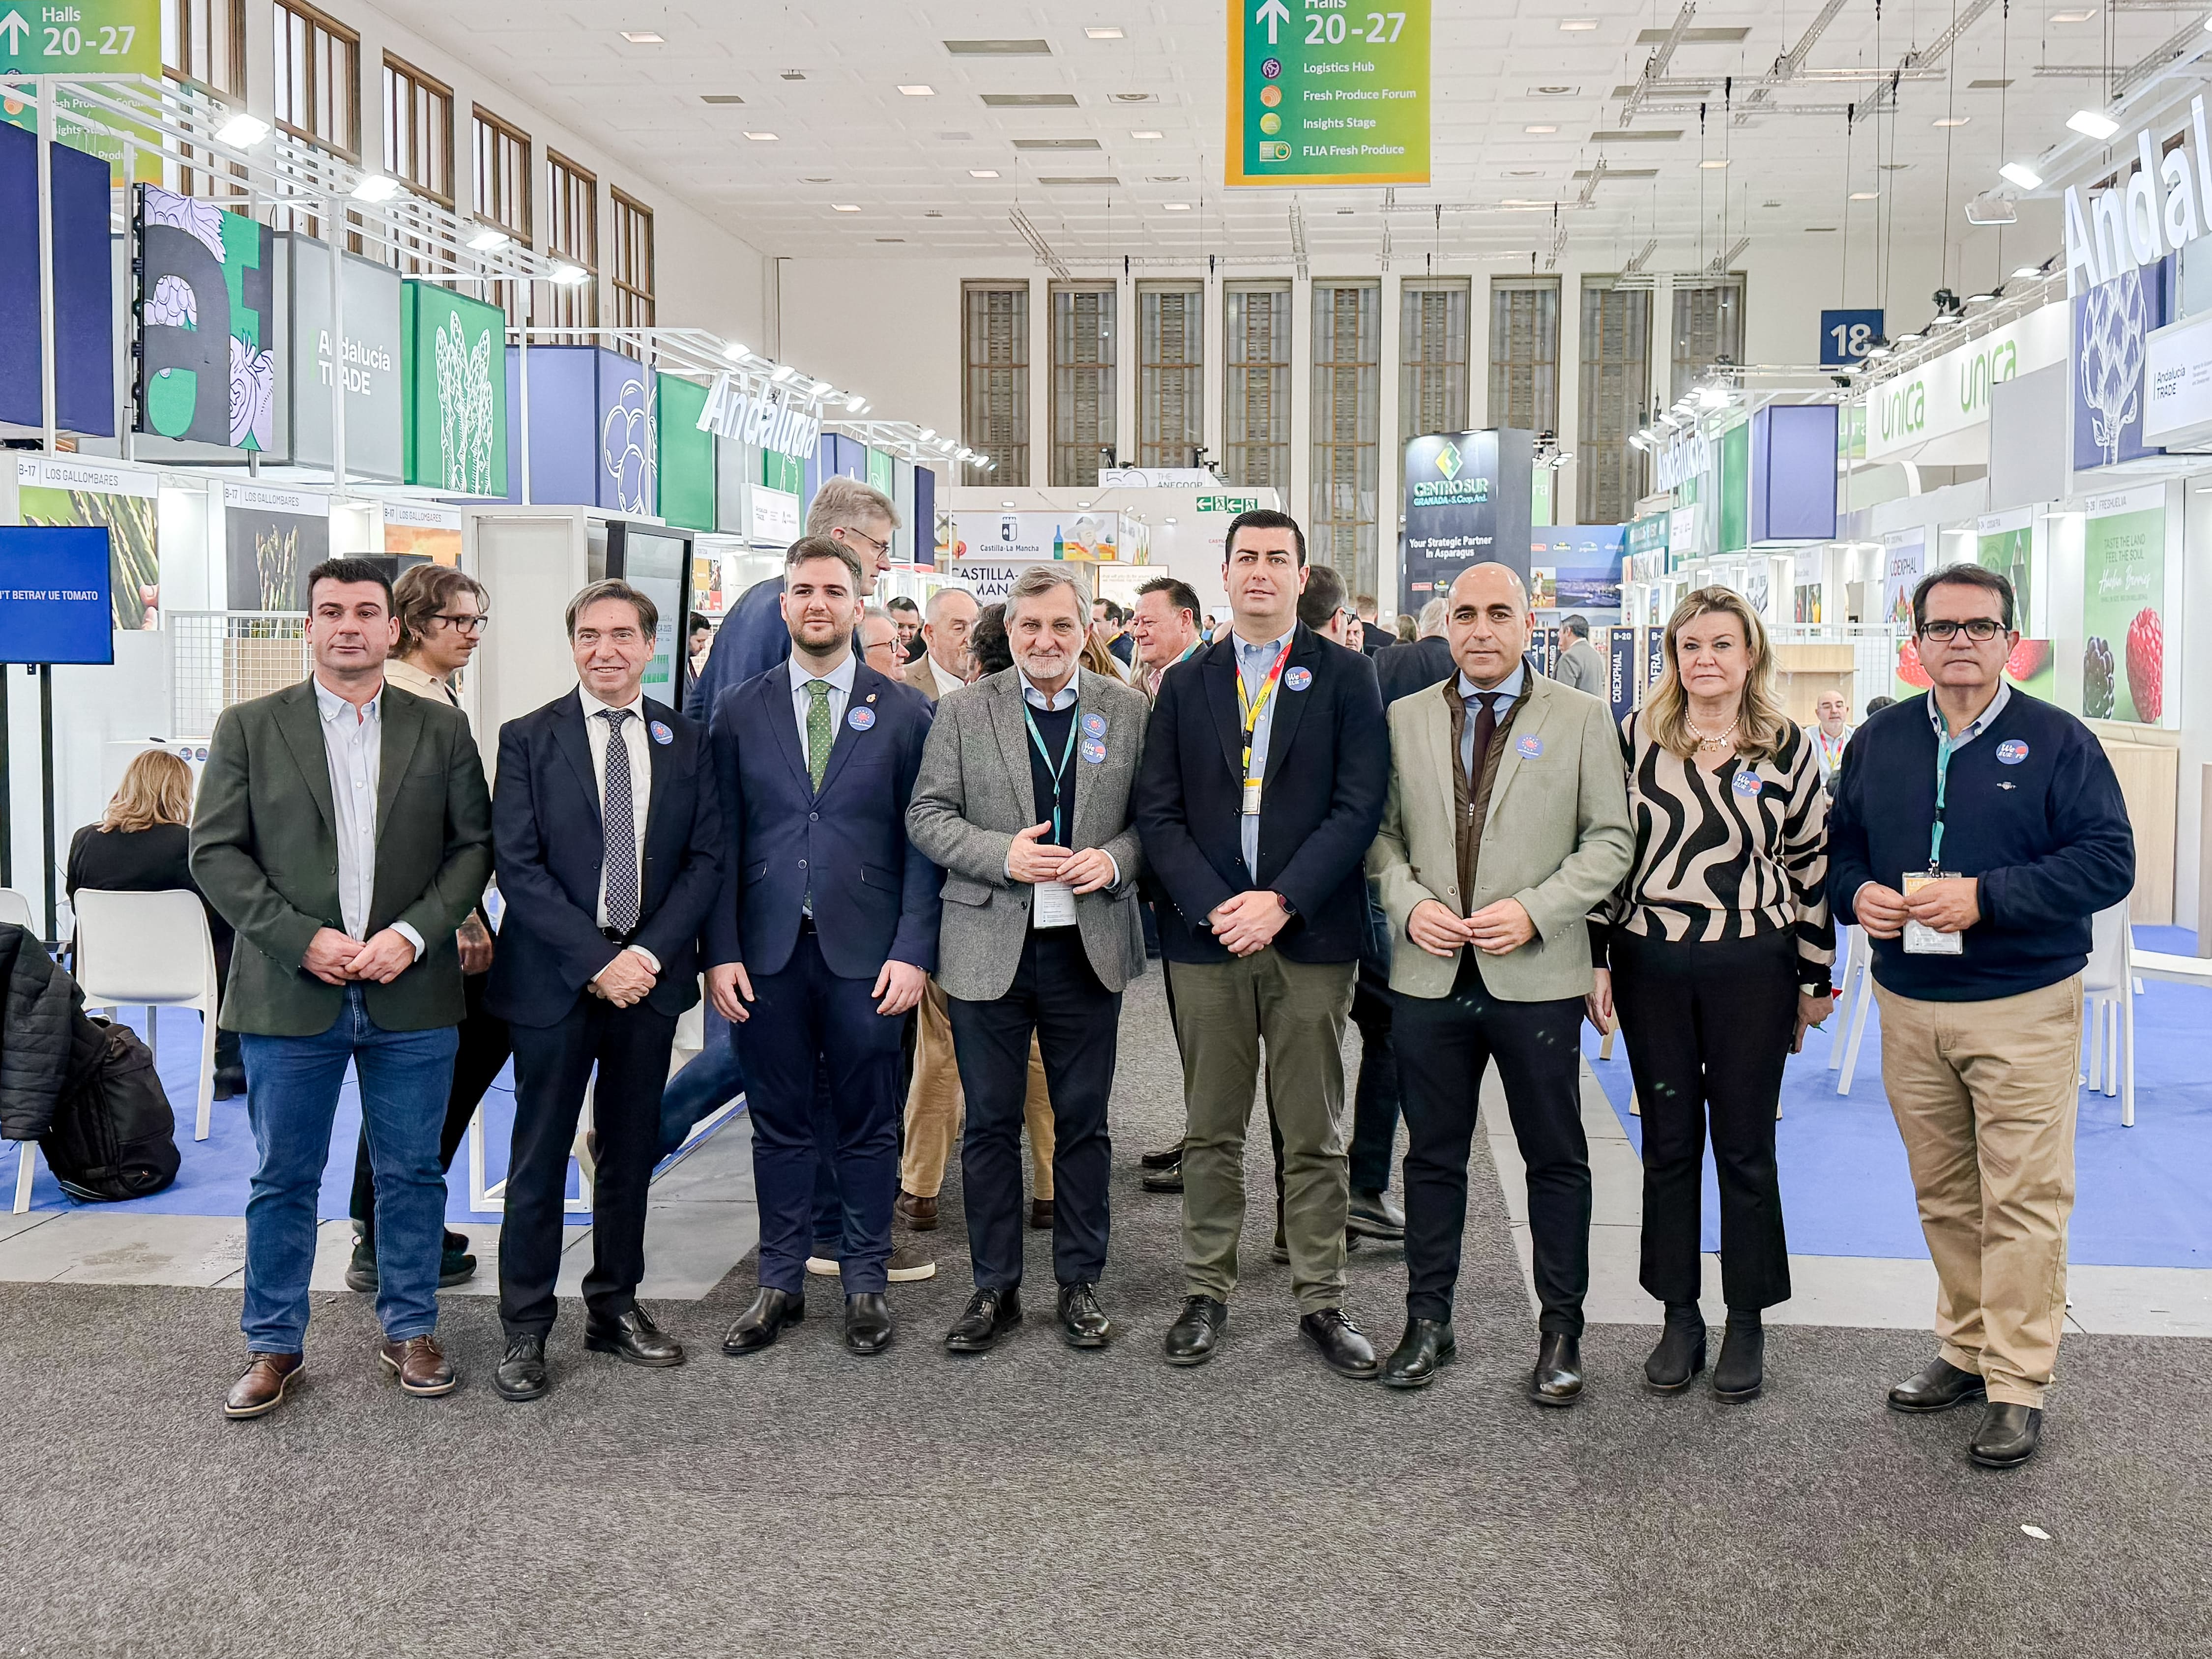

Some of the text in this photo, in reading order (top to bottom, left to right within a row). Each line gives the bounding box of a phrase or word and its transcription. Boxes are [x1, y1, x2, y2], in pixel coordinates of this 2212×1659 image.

[42, 7, 81, 22] Halls
[1304, 61, 1374, 75] Logistics Hub
[1304, 89, 1416, 101] Fresh Produce Forum
[1303, 117, 1376, 130] Insights Stage
[1303, 145, 1404, 156] FLIA Fresh Produce
[1831, 323, 1871, 356] 18
[319, 330, 391, 371] Adalucía
[2156, 382, 2176, 400] TRADE
[1882, 380, 1924, 441] unica
[19, 464, 36, 477] B-17
[45, 468, 118, 486] LOS GALLOMBARES
[225, 488, 237, 499] B-17
[245, 492, 299, 507] LOS GALLOMBARES
[399, 510, 408, 519] LOS
[1409, 536, 1492, 549] Your Strategic Partner
[2104, 533, 2146, 550] TASTE THE LAND
[1434, 548, 1475, 559] Asparagus
[2106, 548, 2144, 563] FEEL THE SOUL
[1890, 556, 1917, 577] COEXPHAL
[952, 567, 1019, 581] ASTILLA-
[0, 591, 98, 600] 'T BETRAY UE TOMATO
[1287, 672, 1300, 681] We
[1612, 651, 1622, 703] COEXPHAL
[2001, 744, 2015, 753] We
[1737, 774, 1750, 786] We
